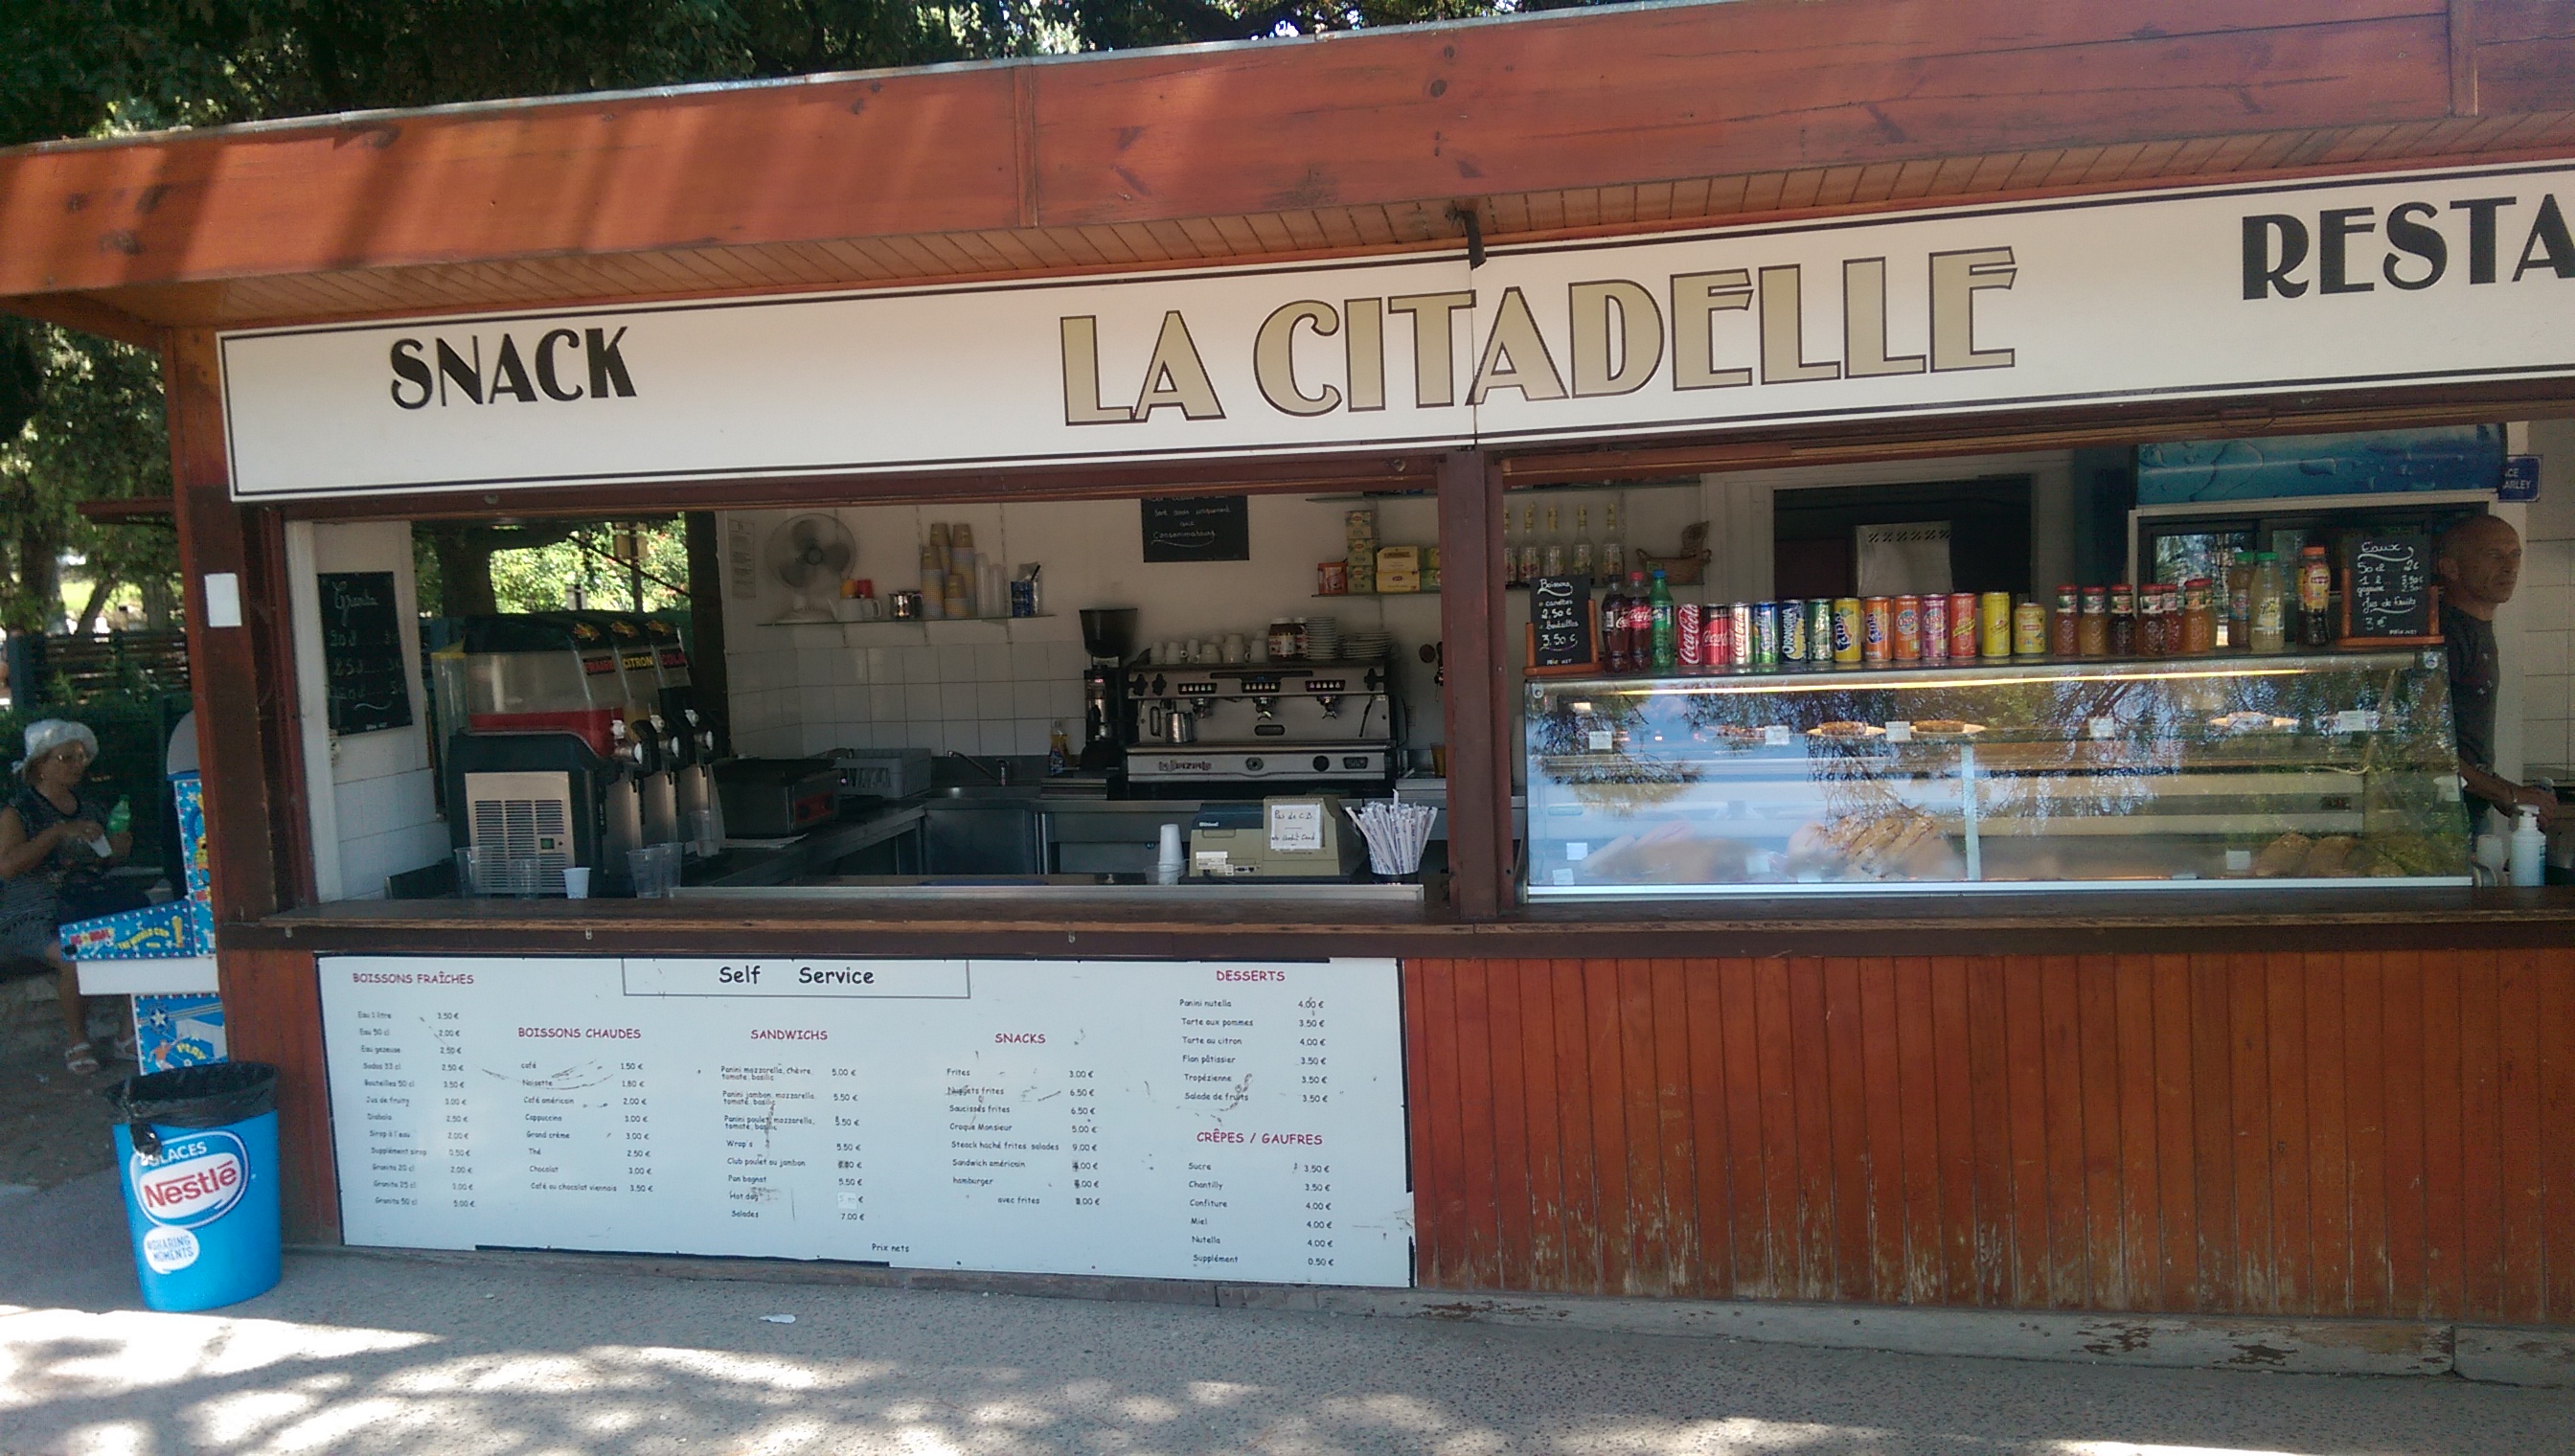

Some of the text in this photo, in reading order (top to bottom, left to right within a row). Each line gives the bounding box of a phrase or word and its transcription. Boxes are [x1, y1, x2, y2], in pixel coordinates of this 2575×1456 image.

[2243, 193, 2575, 300] RESTA
[1060, 246, 2018, 428] LA CITADELLE
[391, 327, 636, 409] SNACK
[623, 655, 653, 668] CITRON
[353, 973, 413, 983] BOISSONS
[718, 966, 875, 985] Self Service
[1217, 970, 1286, 982] DESSERTS
[1181, 1017, 1203, 1026] Tarte
[1222, 1019, 1254, 1028] pommes
[518, 1027, 641, 1039] BOISSONS CHAUDES
[750, 1030, 828, 1040] SANDWICHS
[995, 1034, 1046, 1044] SNACKS
[1201, 1055, 1236, 1063] pâtissier
[1184, 1074, 1232, 1082] Tropézienne
[1196, 1128, 1244, 1143] CRÊPES
[1262, 1133, 1323, 1145] GAUFRES
[979, 1141, 1001, 1149] haché
[780, 1159, 806, 1168] jambon
[144, 1160, 237, 1208] Nestlé
[742, 1175, 766, 1185] bagnat
[953, 1177, 993, 1186] hamburger
[1189, 1181, 1223, 1191] Chantilly
[1190, 1199, 1227, 1208] Confiture
[1192, 1236, 1220, 1244] Nutella
[872, 1243, 888, 1252] Prix
[1193, 1254, 1238, 1263] Supplément
